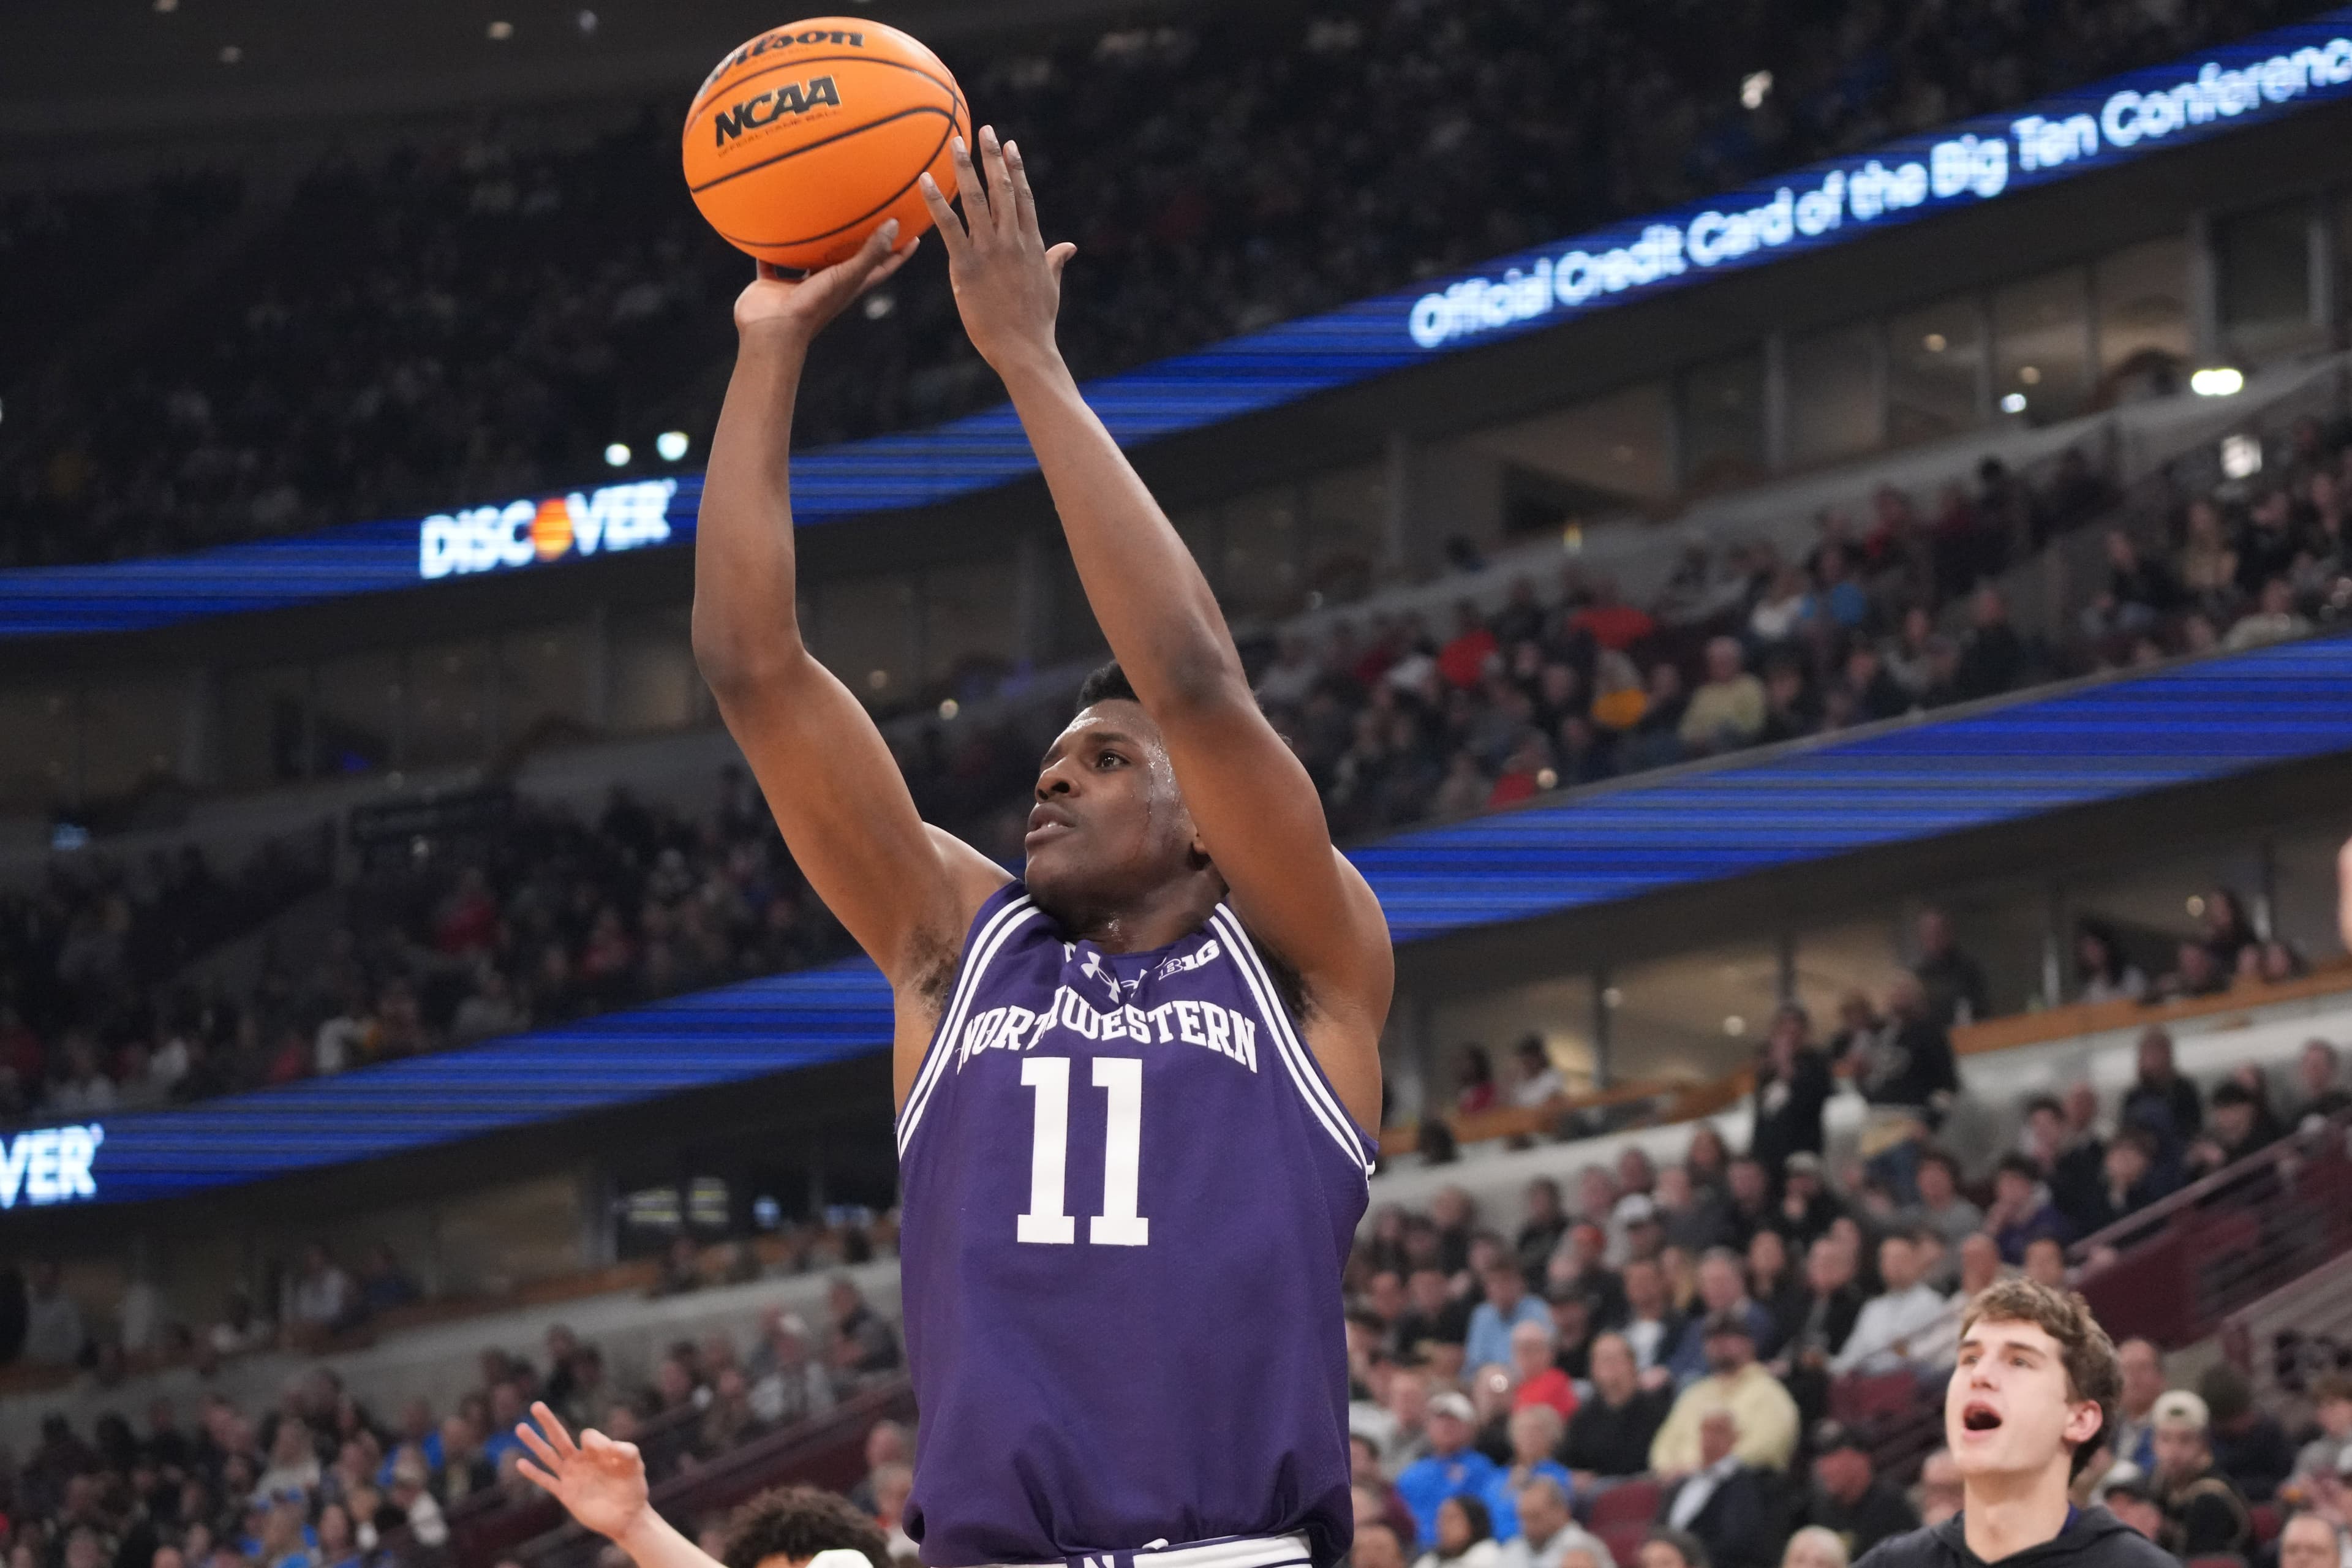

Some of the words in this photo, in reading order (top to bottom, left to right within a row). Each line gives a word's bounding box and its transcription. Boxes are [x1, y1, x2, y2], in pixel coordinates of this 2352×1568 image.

[715, 74, 842, 148] NCAA
[1409, 258, 1553, 348] Official
[1554, 225, 1687, 306] Credit
[1687, 186, 1794, 266] Card
[1795, 170, 1845, 235] of
[1849, 160, 1928, 221] the
[1930, 135, 2008, 198] Big
[2011, 114, 2098, 171] Ten
[420, 480, 671, 579] DISCOVER
[1017, 1057, 1148, 1246] 11
